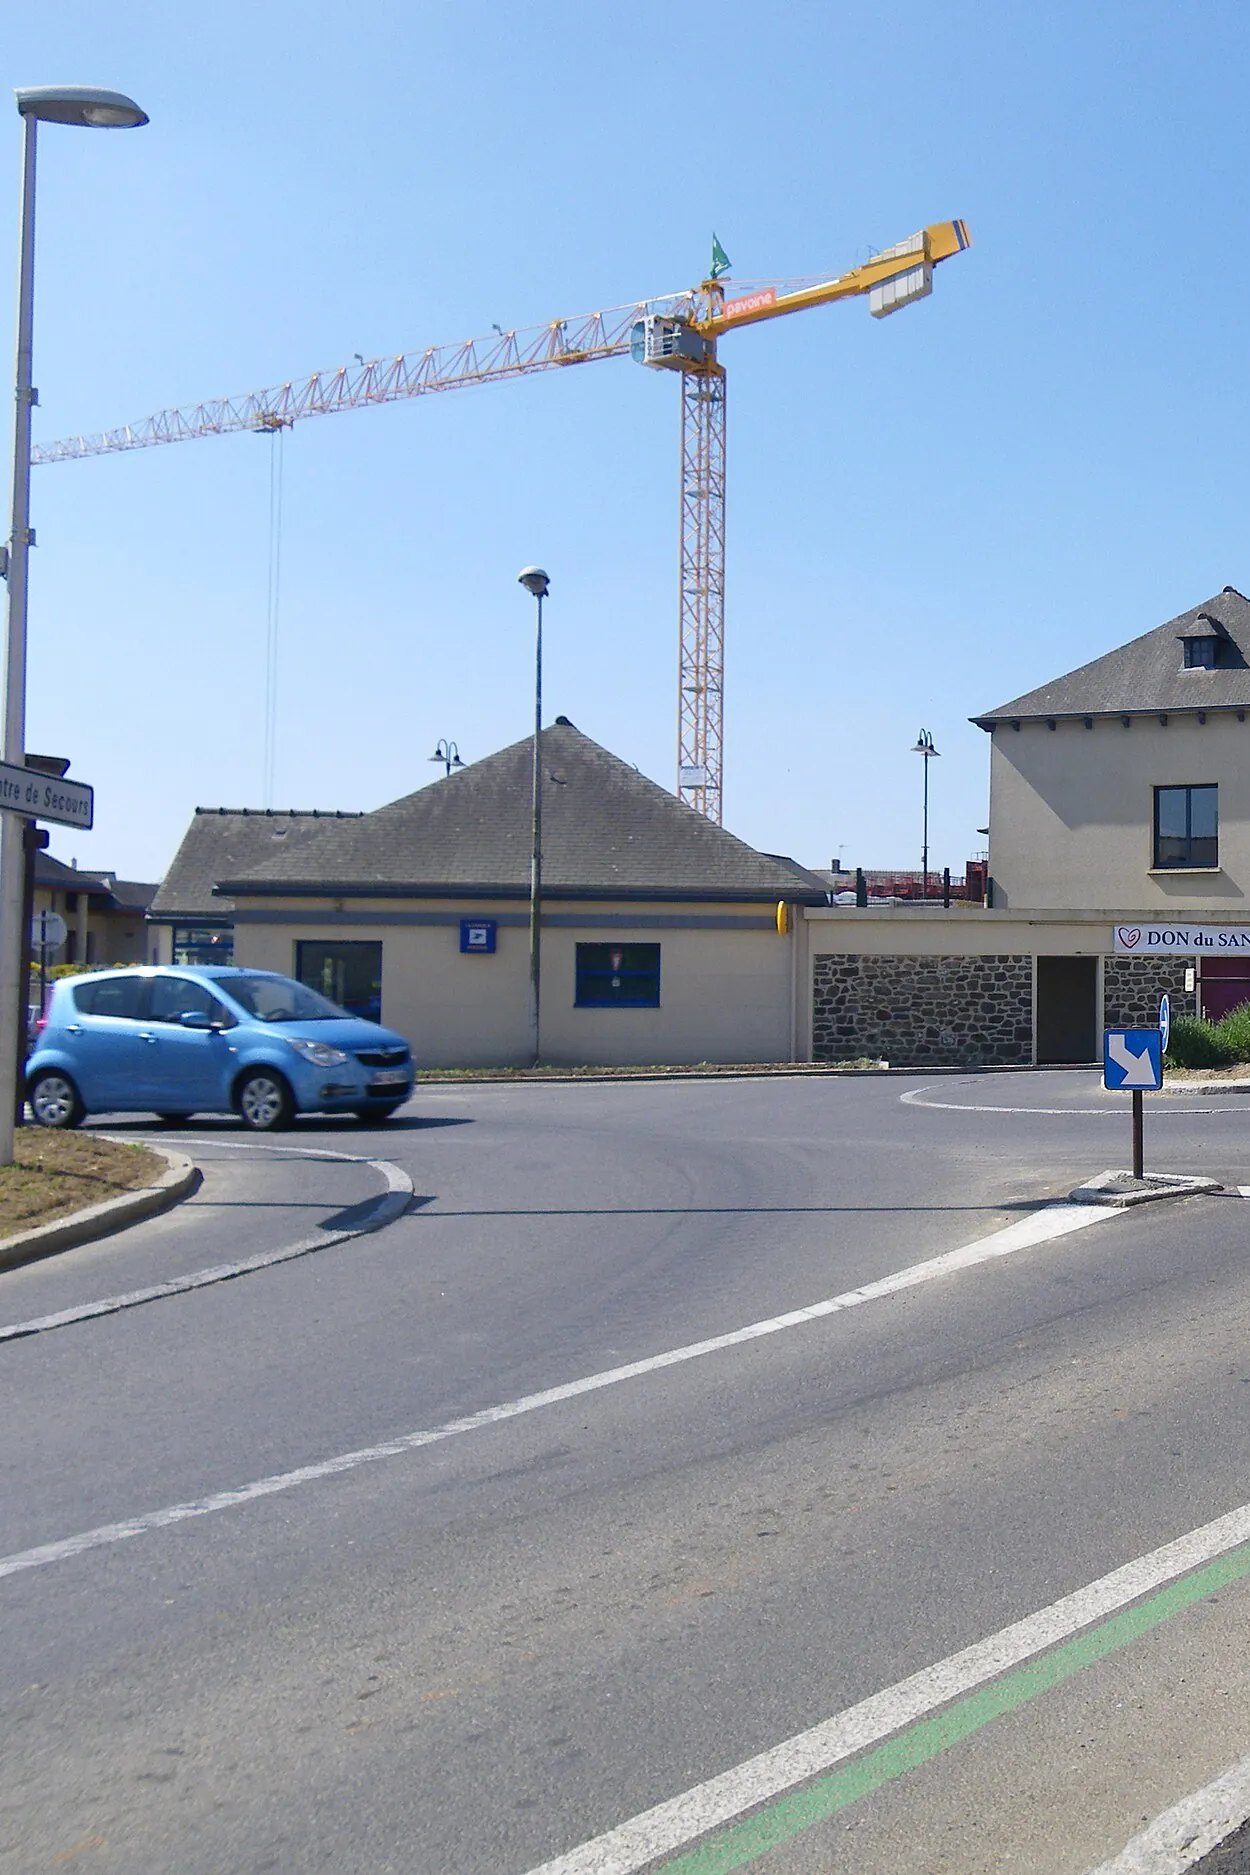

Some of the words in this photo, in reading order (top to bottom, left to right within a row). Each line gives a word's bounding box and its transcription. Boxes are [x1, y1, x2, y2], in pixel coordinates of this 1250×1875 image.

[25, 782, 39, 805] de
[43, 785, 89, 816] Secours
[1147, 930, 1190, 946] DON
[1193, 932, 1214, 947] du
